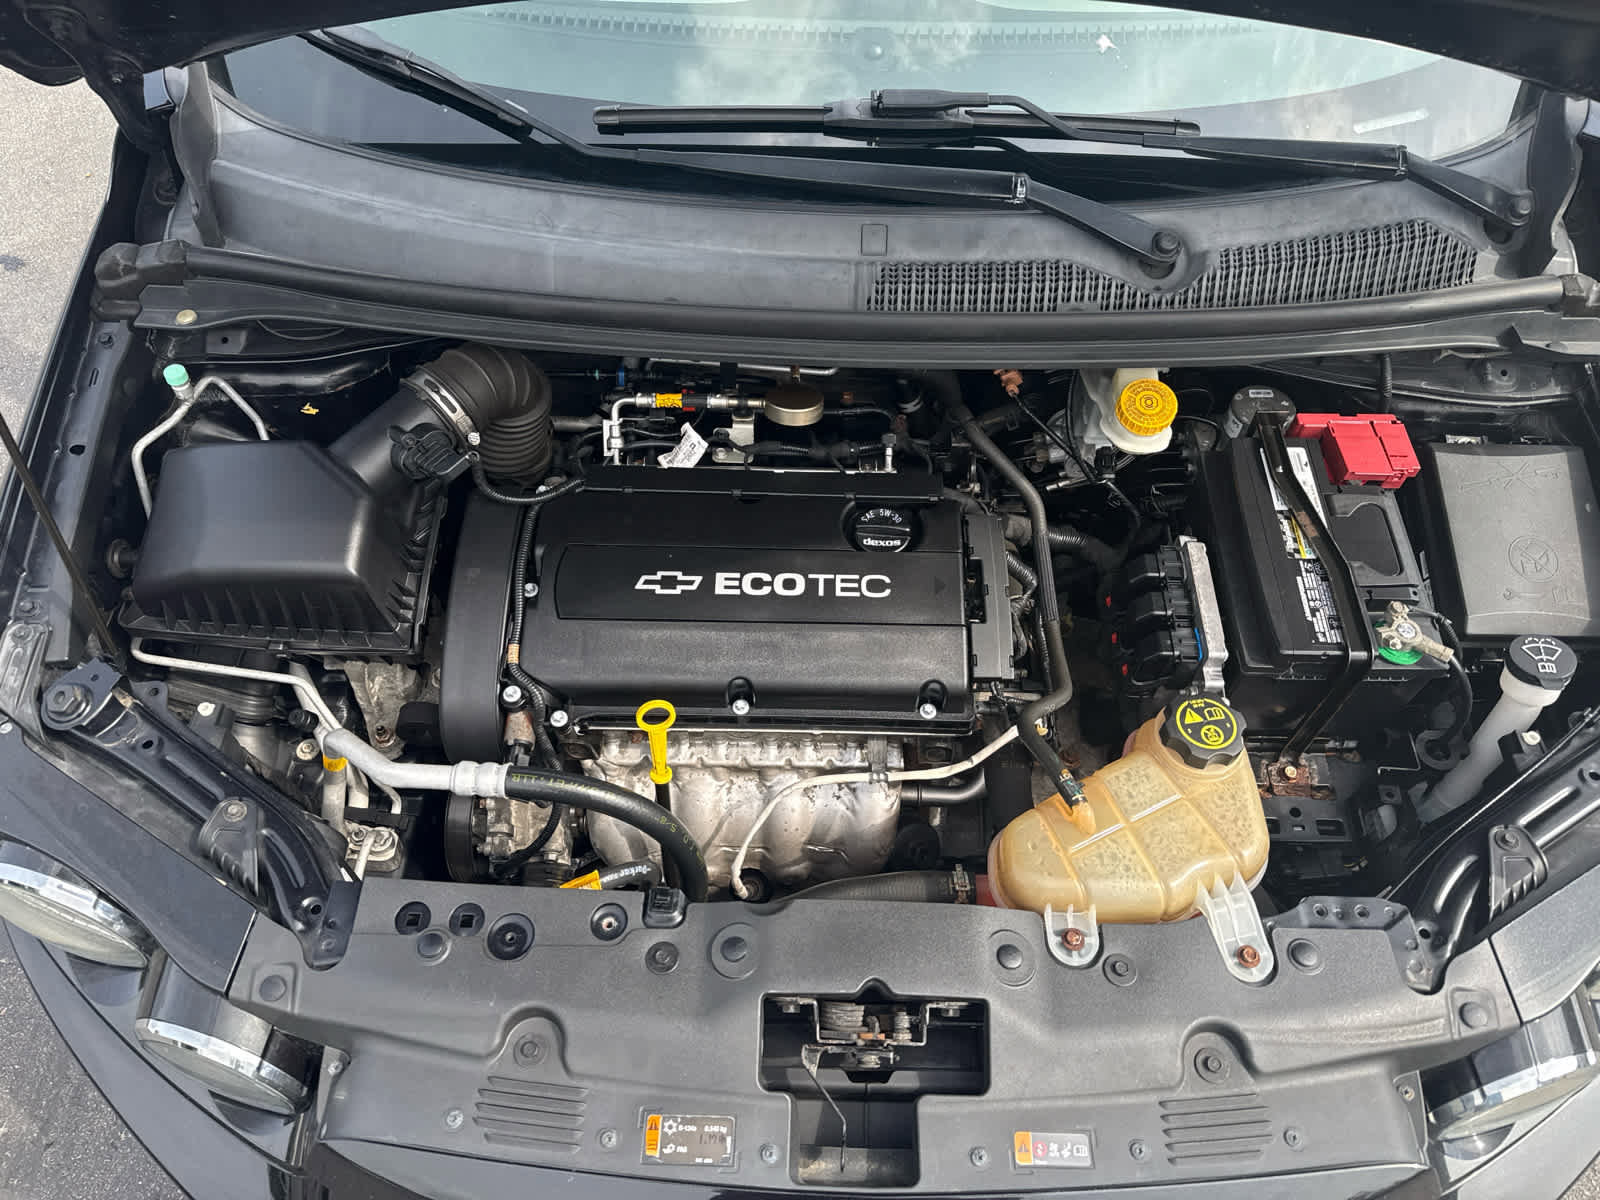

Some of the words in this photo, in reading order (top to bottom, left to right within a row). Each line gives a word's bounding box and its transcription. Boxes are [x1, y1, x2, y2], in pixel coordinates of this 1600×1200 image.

[860, 510, 876, 522] SAE
[879, 508, 903, 524] 5W-30
[863, 537, 901, 546] dexos
[714, 572, 892, 598] ECOTEC
